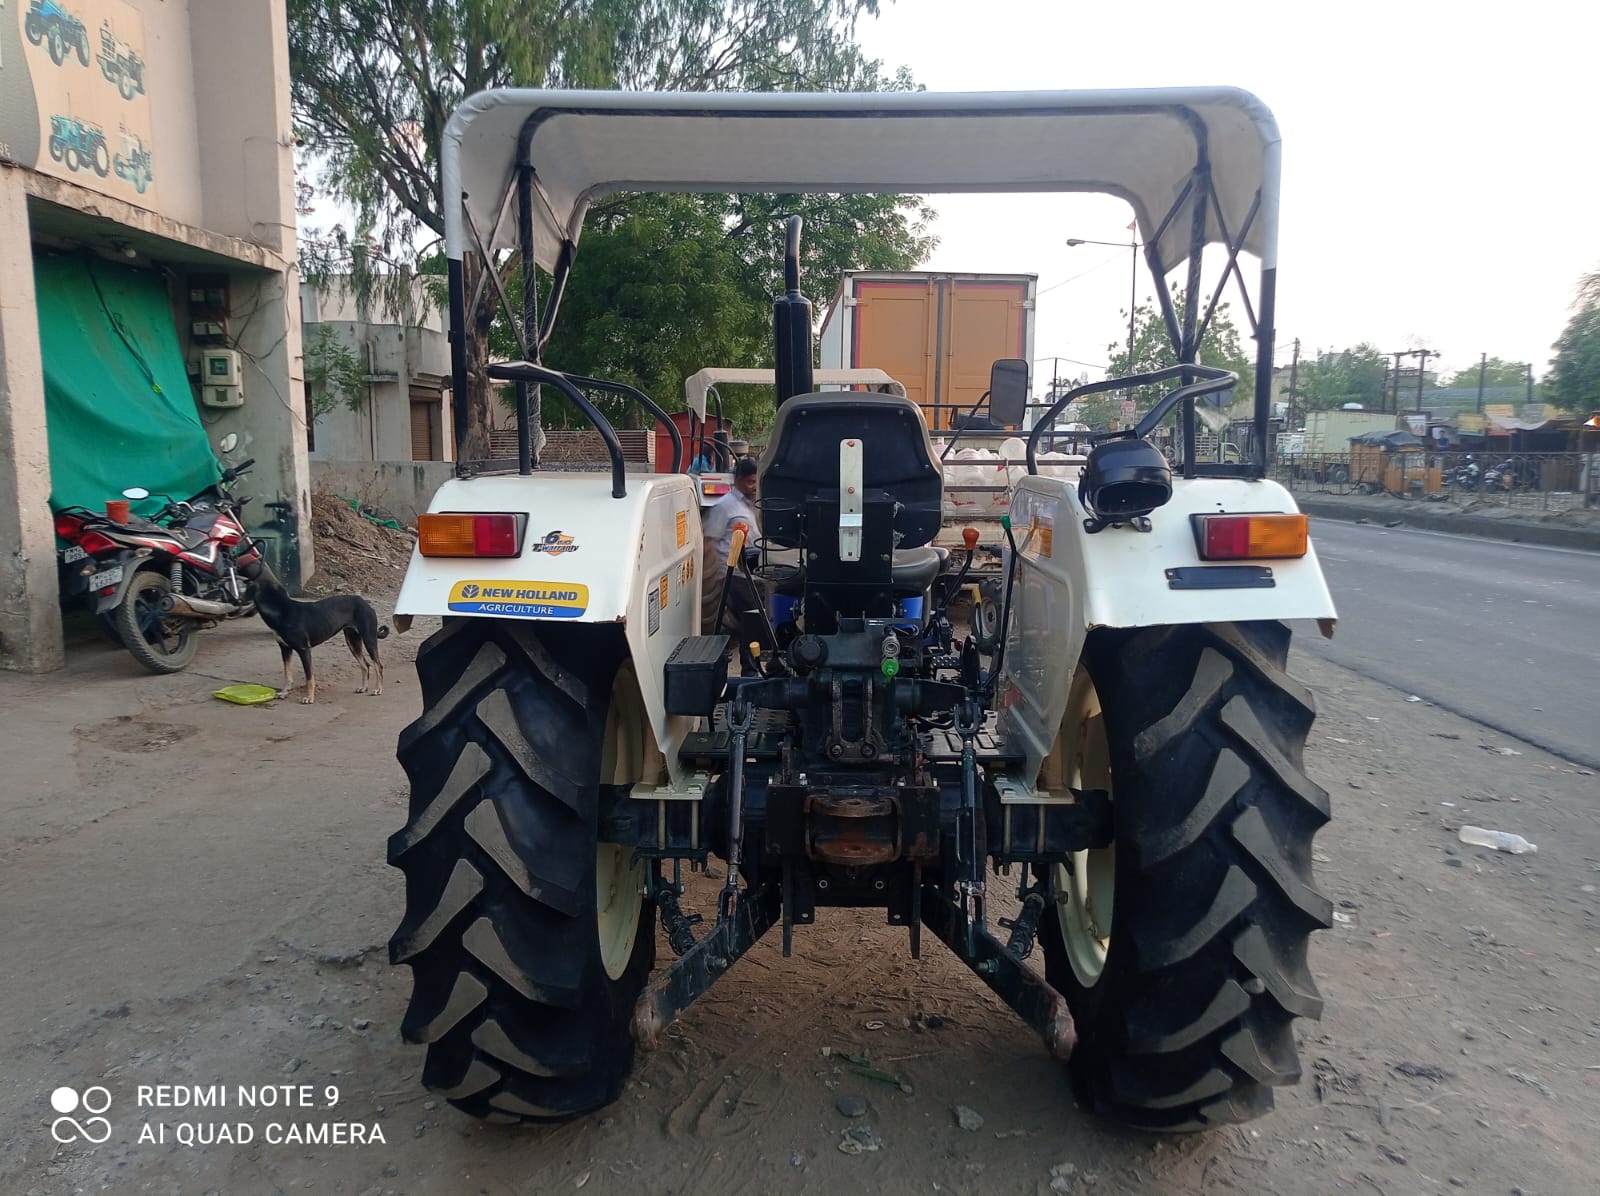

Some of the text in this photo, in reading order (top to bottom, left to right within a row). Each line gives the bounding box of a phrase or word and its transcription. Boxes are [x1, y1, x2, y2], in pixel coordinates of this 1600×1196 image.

[482, 588, 578, 600] NEW HOLLAND
[478, 603, 554, 615] AGRICULTURE
